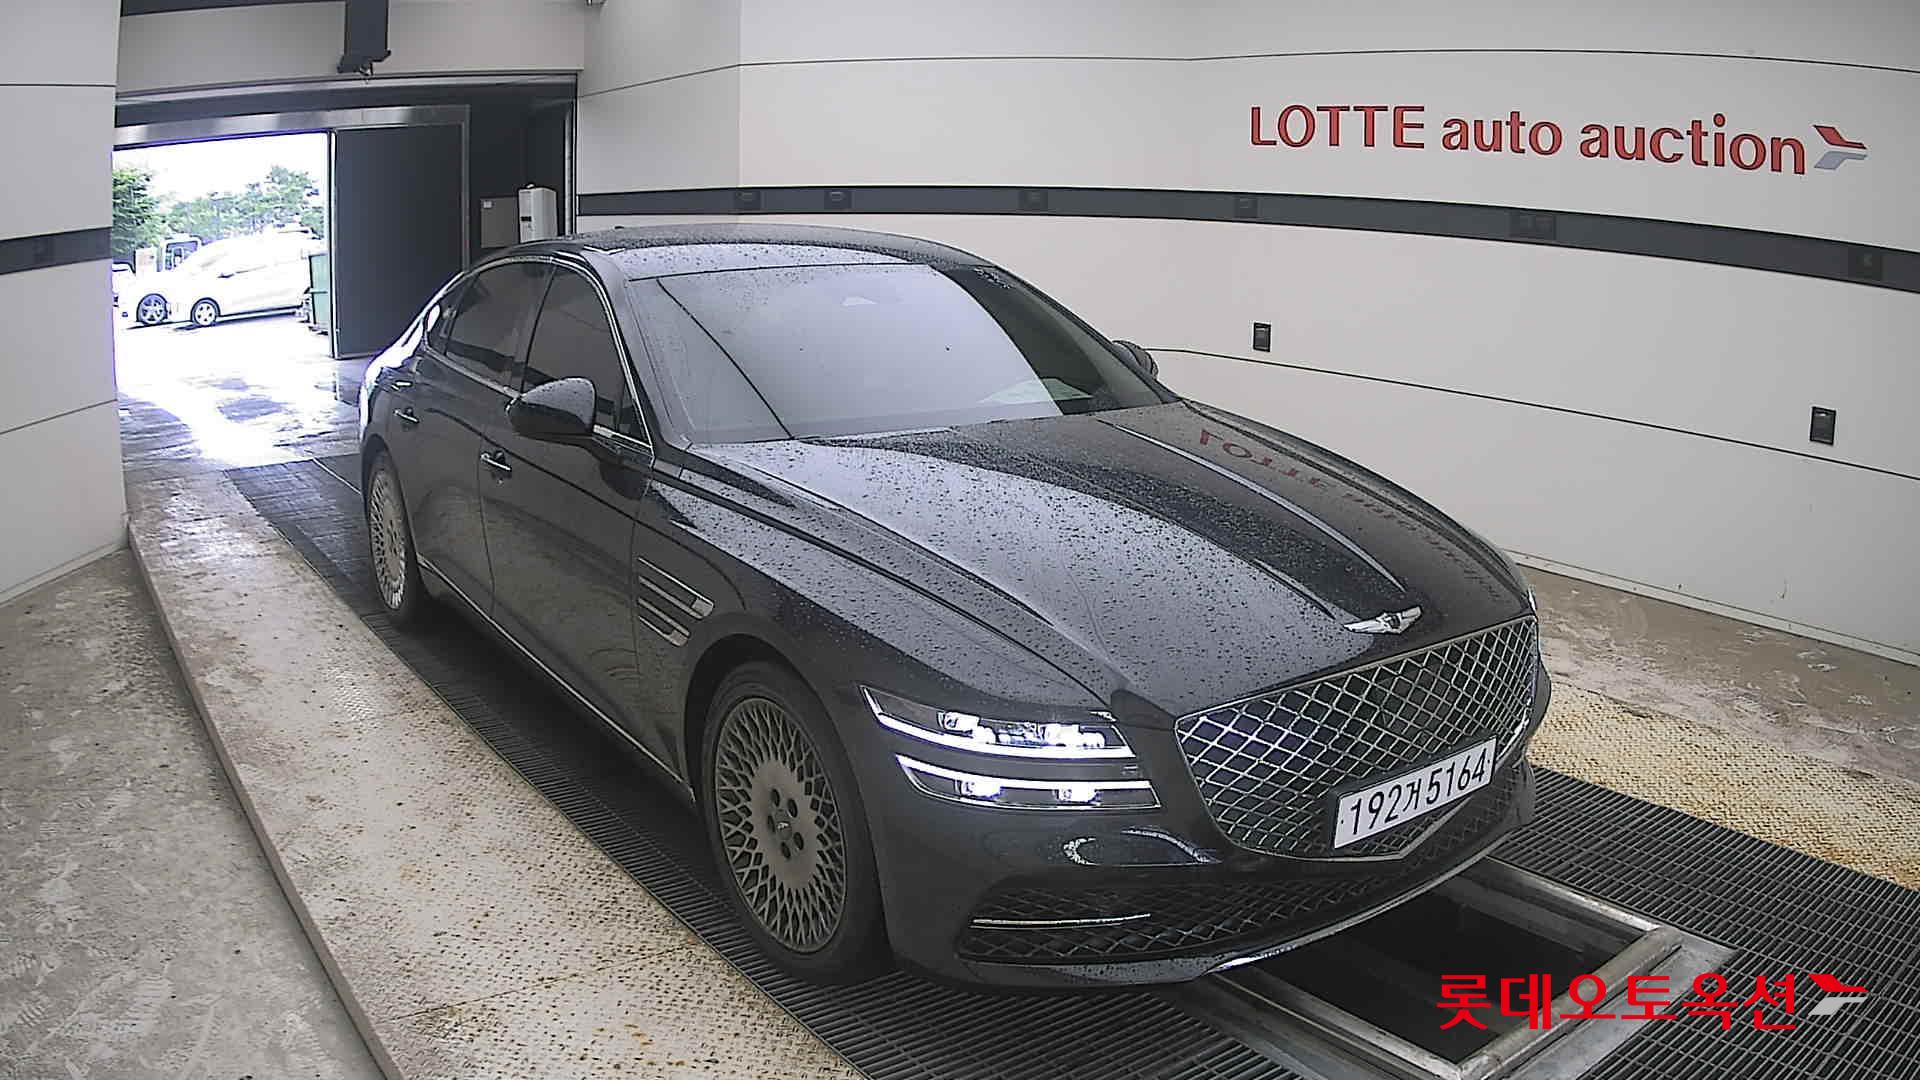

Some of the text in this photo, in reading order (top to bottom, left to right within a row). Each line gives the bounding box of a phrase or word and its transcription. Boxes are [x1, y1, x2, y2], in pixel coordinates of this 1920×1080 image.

[1250, 105, 1806, 175] LOTTE auto auction
